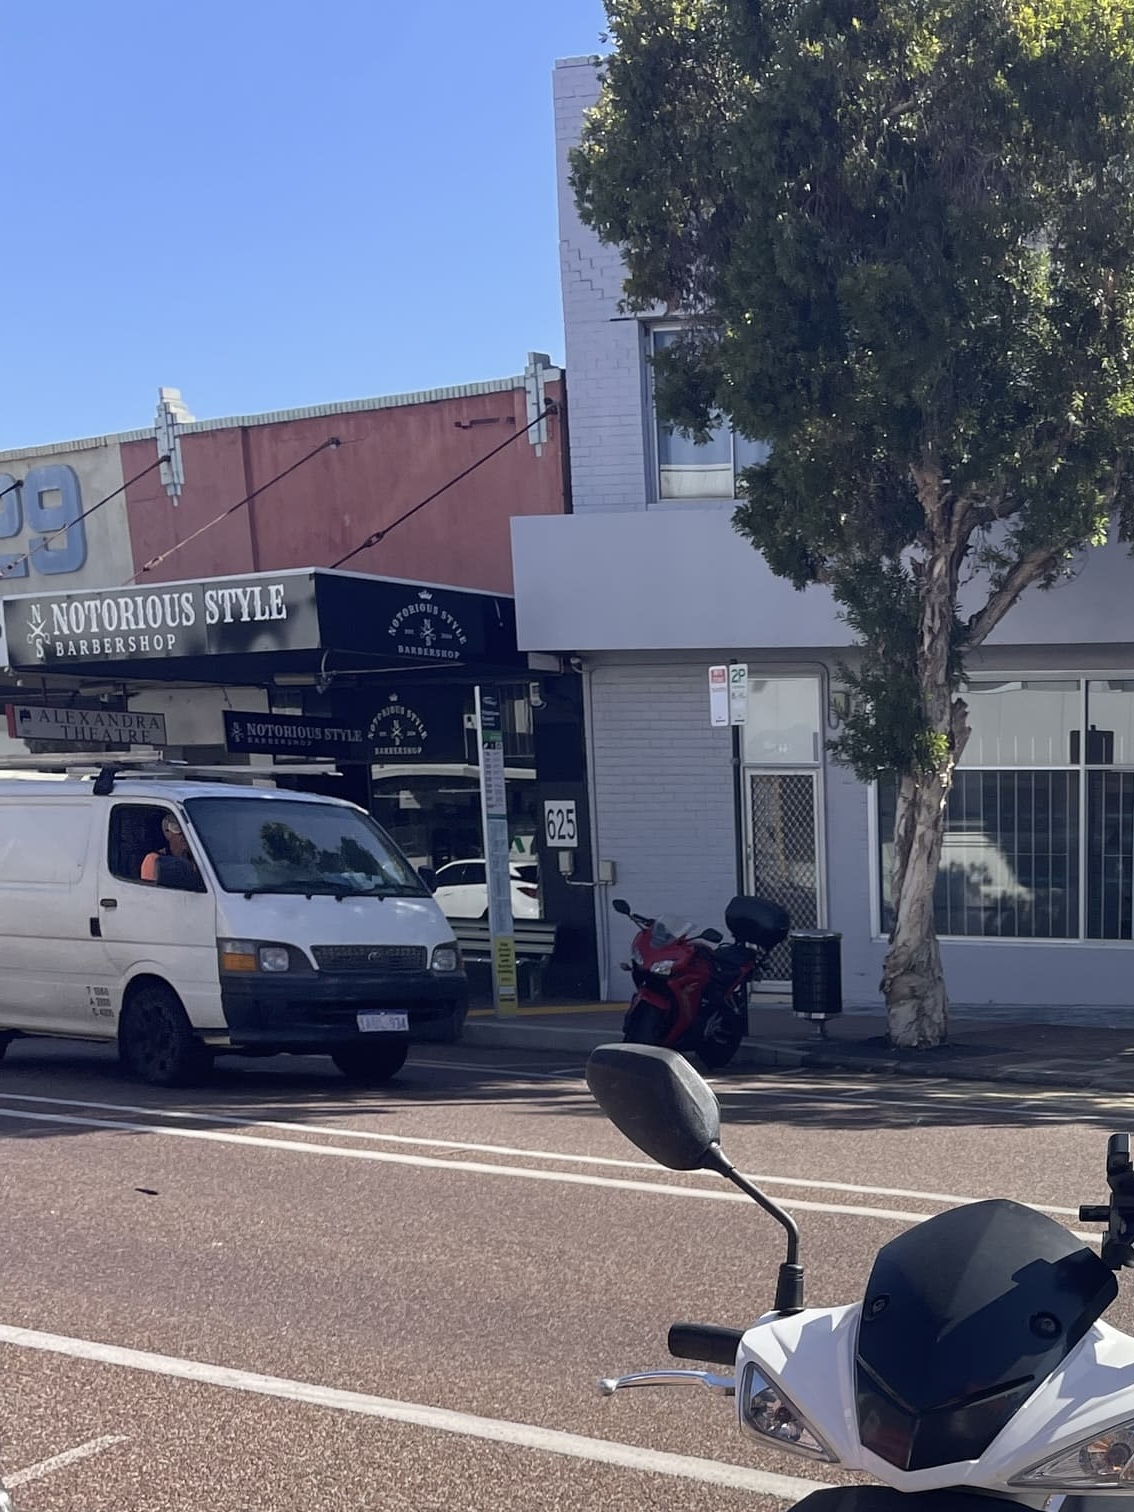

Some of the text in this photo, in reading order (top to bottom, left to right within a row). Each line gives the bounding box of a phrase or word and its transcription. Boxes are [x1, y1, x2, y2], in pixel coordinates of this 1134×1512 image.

[50, 583, 288, 636] NOTORIOUS STYLE
[388, 602, 468, 645] NOTORIOUS STYLE
[56, 634, 176, 658] BARBERSHOP
[397, 645, 461, 660] BARBERSHOP
[731, 668, 746, 683] 2P
[37, 708, 161, 731] ALEXANDRA
[367, 705, 429, 740] NOTORIOUS STYLE
[60, 725, 150, 744] THEATRE
[246, 722, 364, 743] NOTORIOUS STYLE
[374, 746, 422, 756] BARBERSHOP
[546, 808, 576, 840] 625
